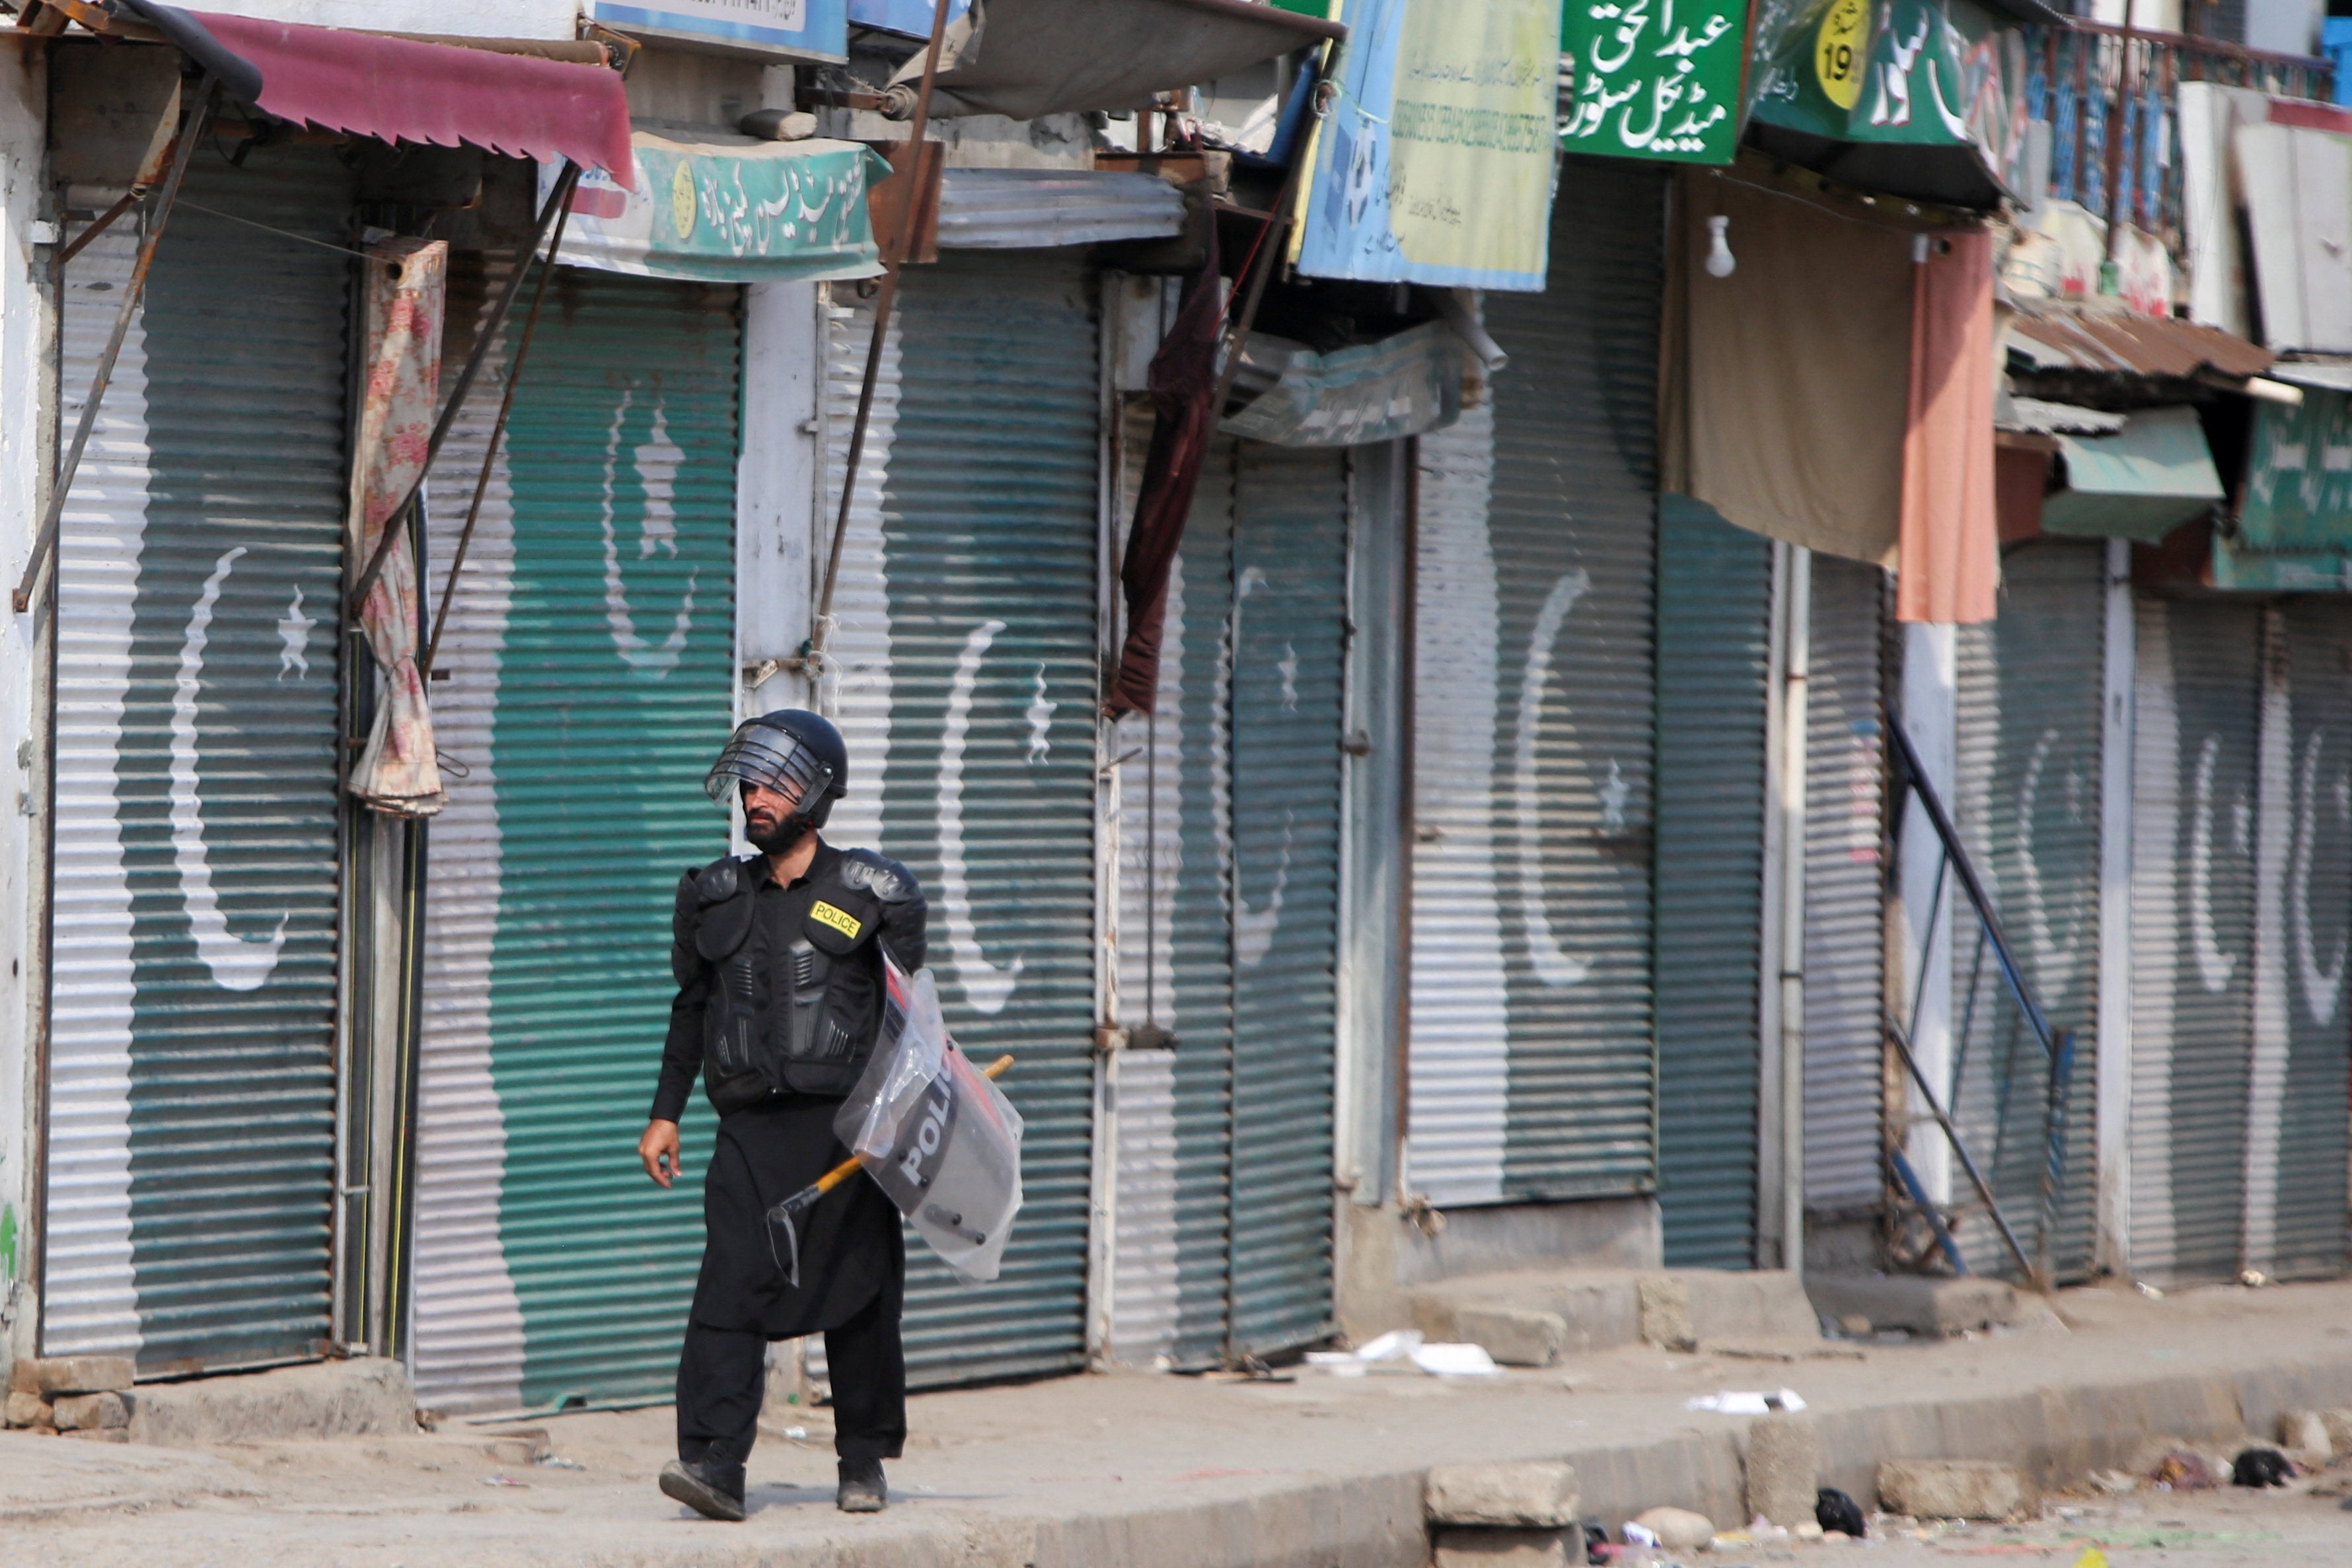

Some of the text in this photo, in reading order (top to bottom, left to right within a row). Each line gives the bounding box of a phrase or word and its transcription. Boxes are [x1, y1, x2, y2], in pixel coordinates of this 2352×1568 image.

[1559, 71, 1642, 137] سٹور
[1619, 74, 1726, 152] میڈیکل
[815, 904, 857, 935] POLICE
